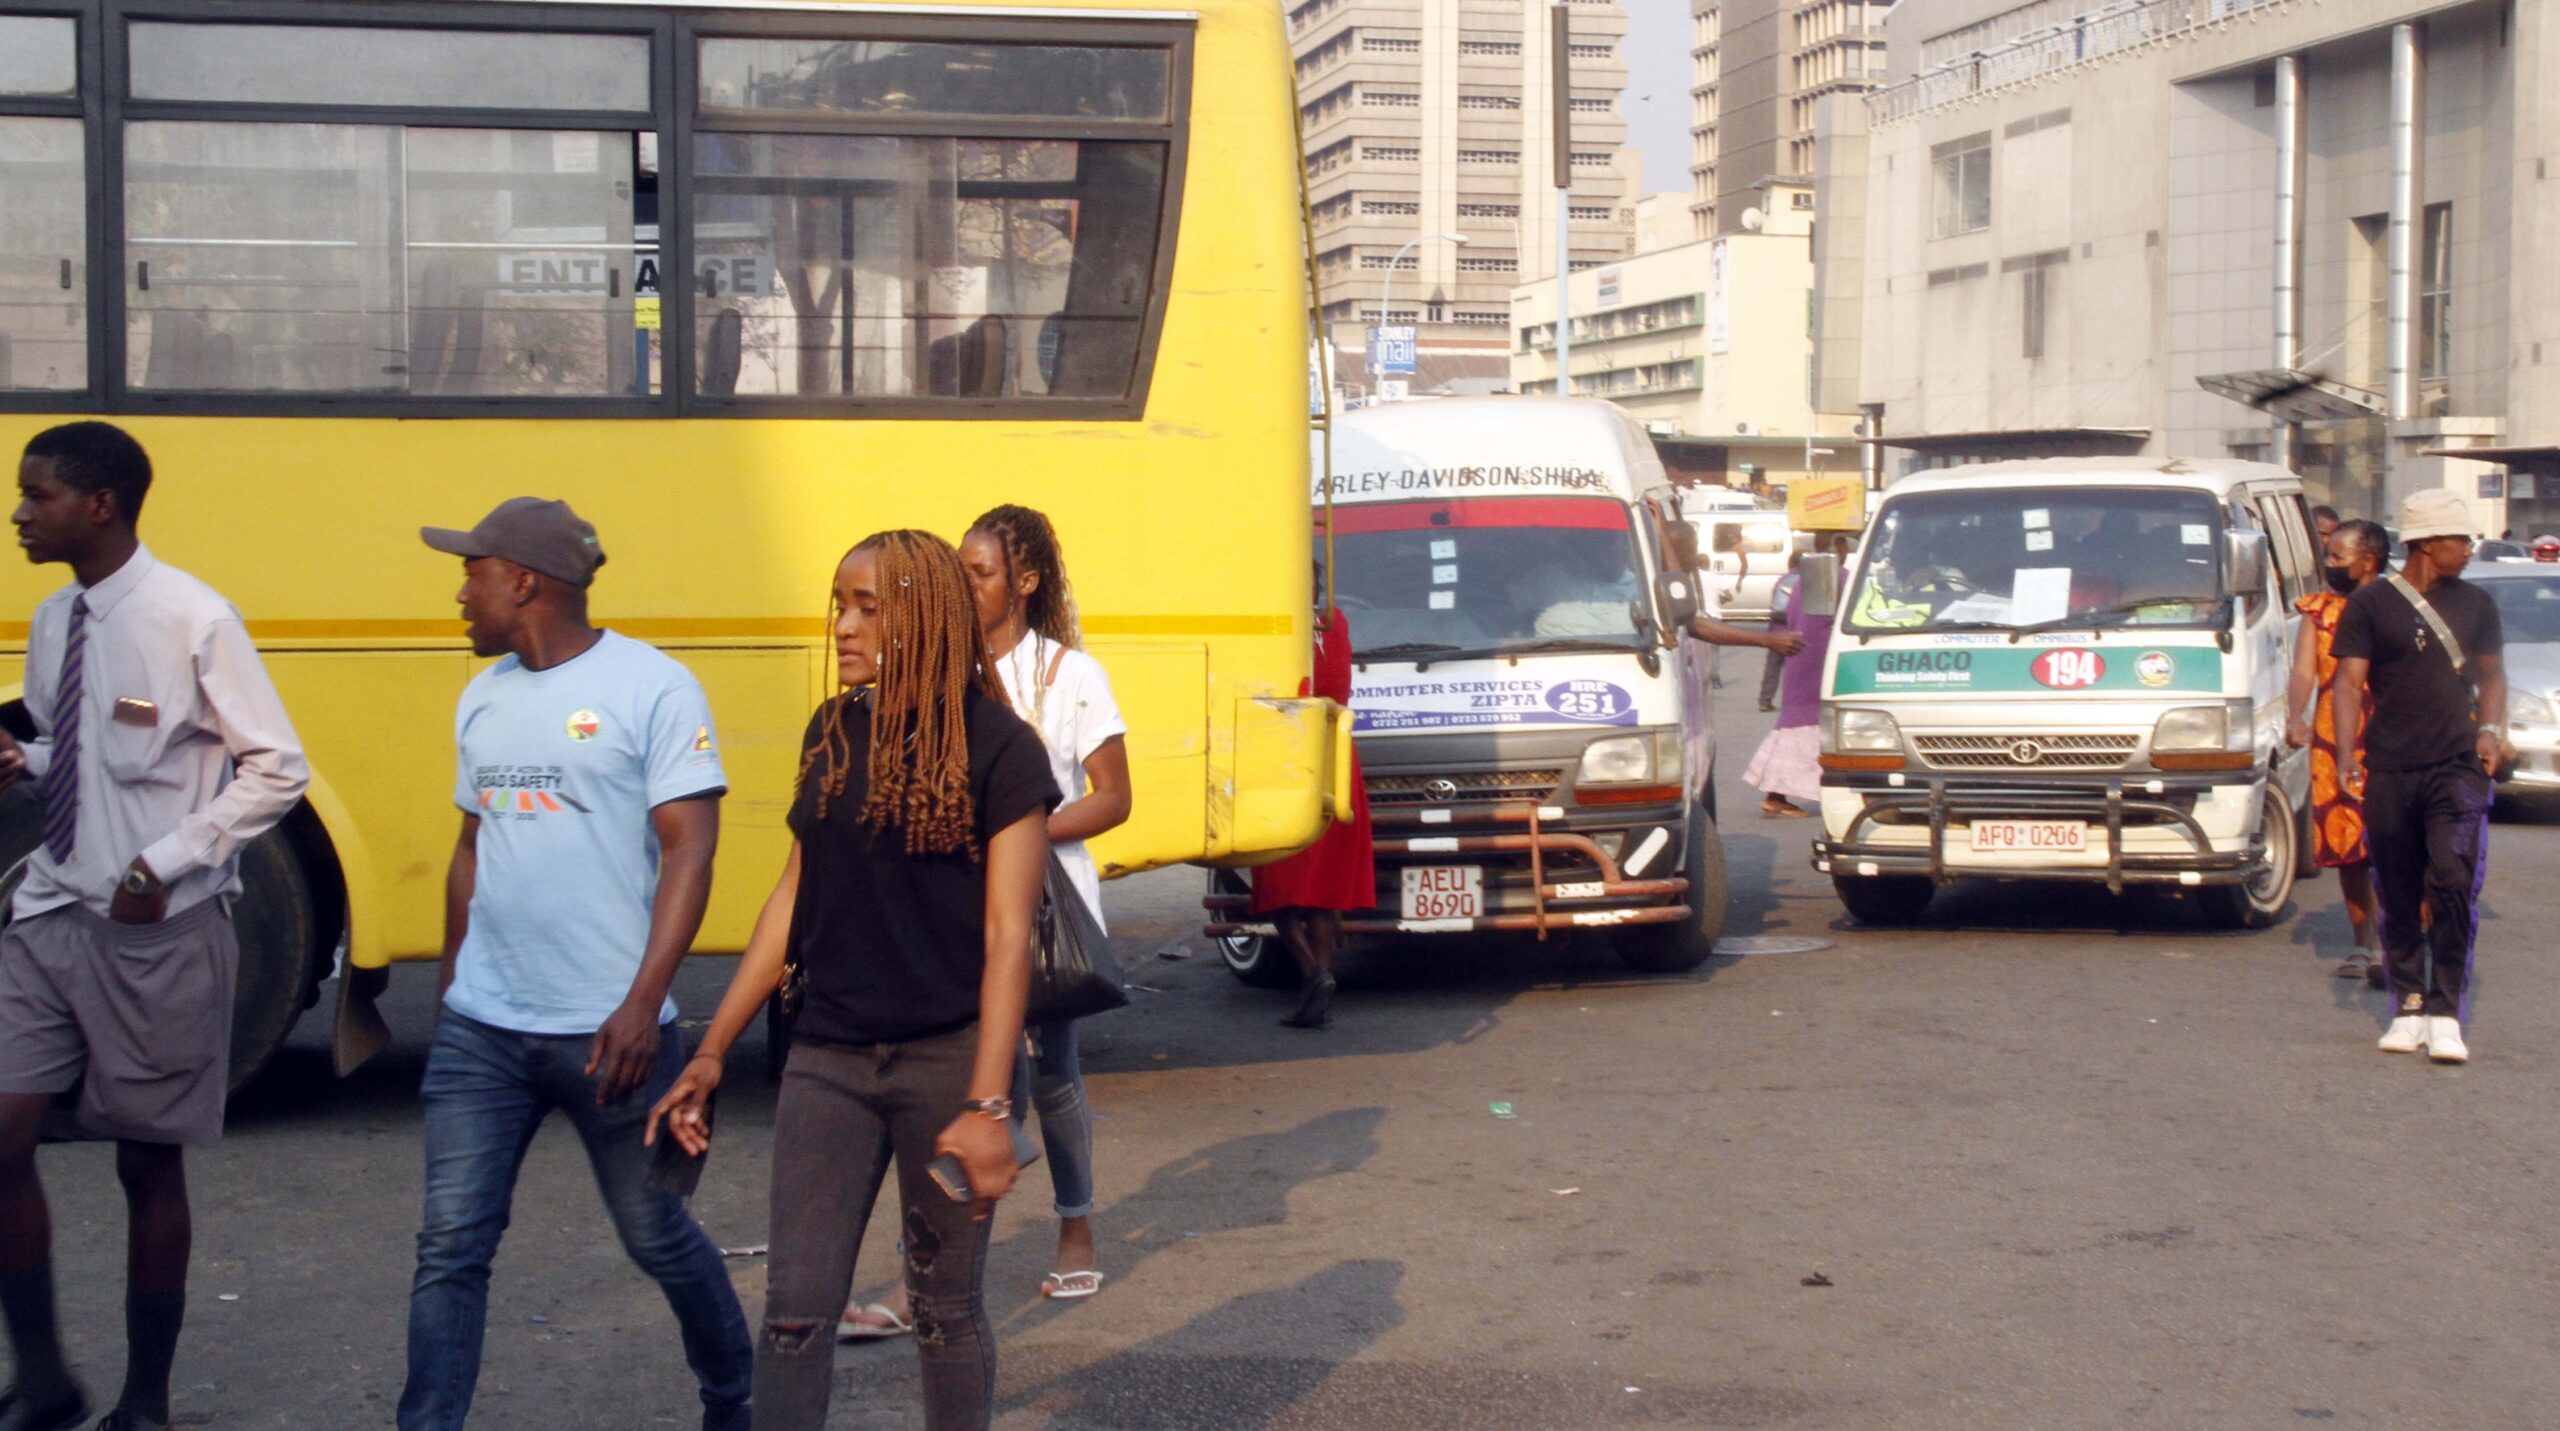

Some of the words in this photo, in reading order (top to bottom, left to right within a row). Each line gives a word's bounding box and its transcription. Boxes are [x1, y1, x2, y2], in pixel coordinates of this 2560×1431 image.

[512, 259, 757, 293] ENTACE
[1877, 651, 1972, 673] GHACO
[2045, 651, 2097, 685] 194
[1449, 681, 1543, 694] SERVICES
[1569, 680, 1608, 692] HRE
[1471, 694, 1538, 707] ZIPTA
[1559, 692, 1616, 715] 251
[509, 775, 562, 789] SAFETY
[1979, 825, 2015, 846] AFQ
[2031, 825, 2079, 846] 0206
[1419, 869, 1466, 892] AEU
[1416, 893, 1474, 917] 8690
